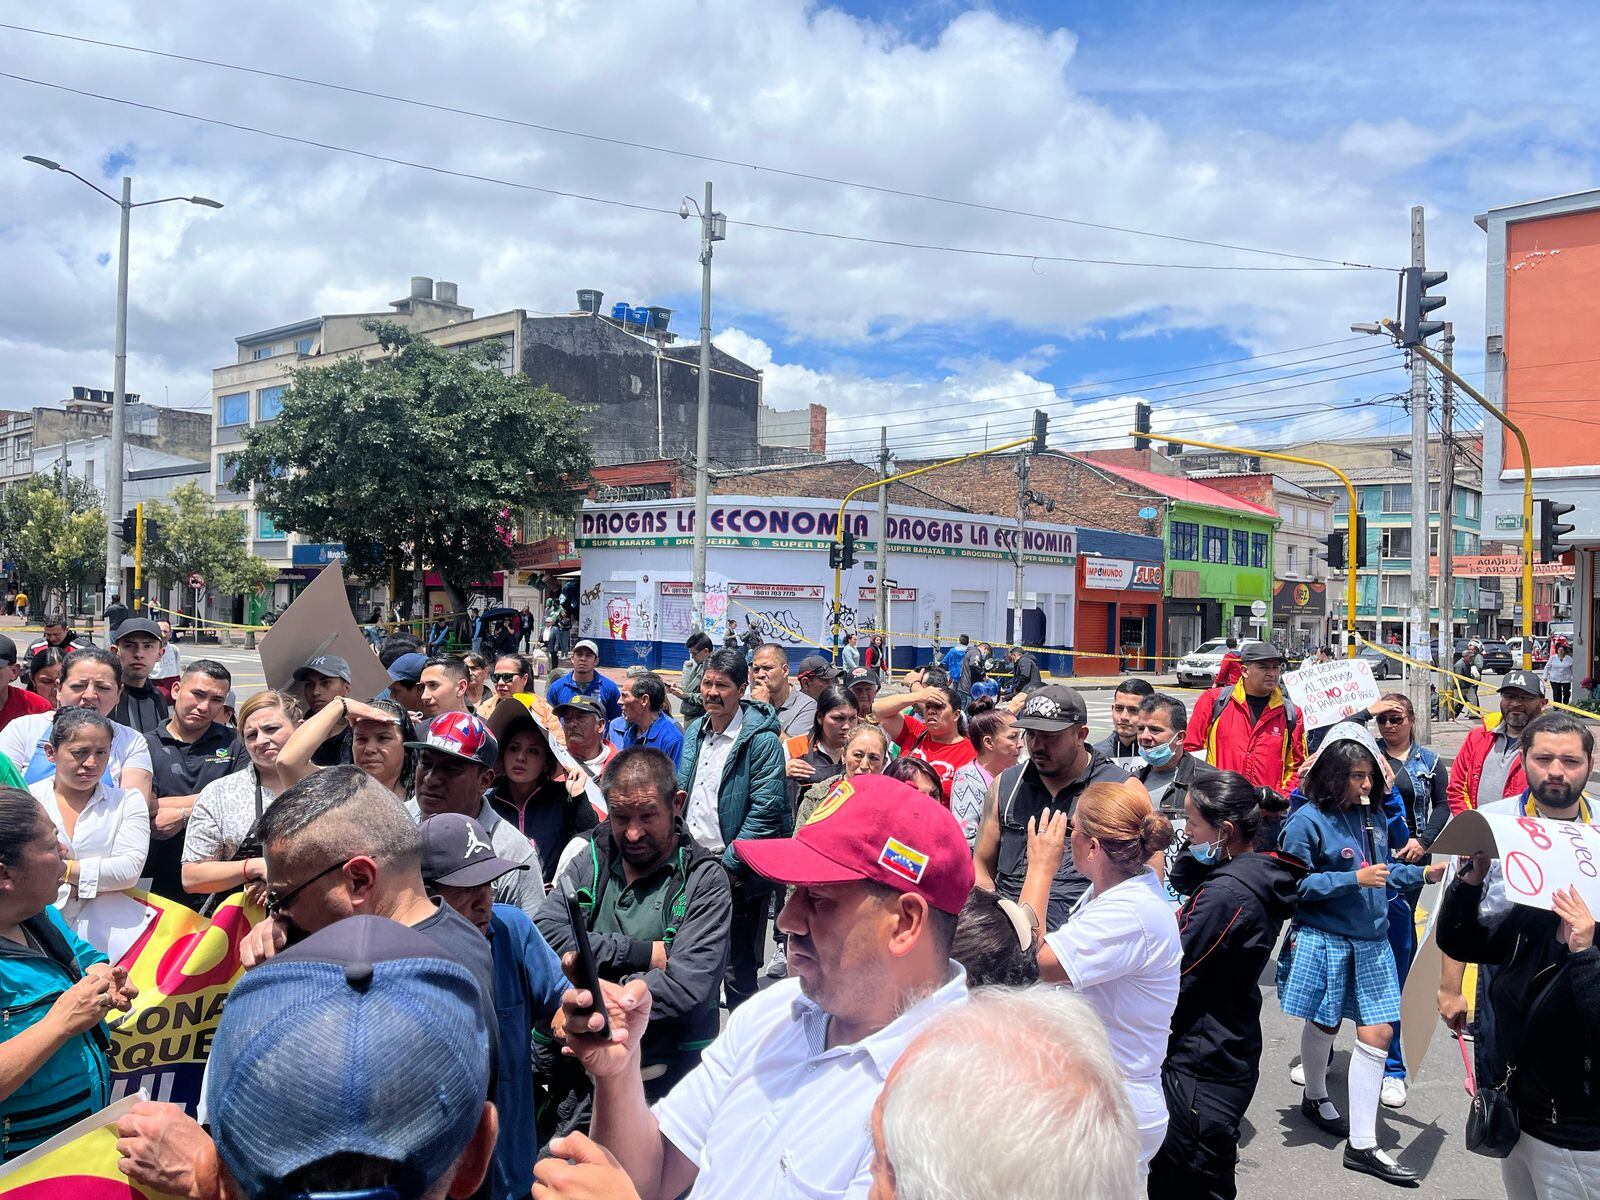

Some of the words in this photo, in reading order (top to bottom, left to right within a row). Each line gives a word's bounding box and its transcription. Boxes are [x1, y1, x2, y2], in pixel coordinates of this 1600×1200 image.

[582, 511, 667, 534] DROGAS
[710, 509, 868, 537] ECONOMIA
[886, 517, 964, 544] DROGAS
[970, 524, 988, 546] LA
[591, 539, 618, 547] SUPER
[619, 538, 657, 547] BARATAS
[771, 540, 814, 549] SUPER
[913, 547, 945, 555] BARATAS
[961, 550, 1003, 559] DROGUERIA
[1298, 669, 1318, 681] POR
[1317, 661, 1350, 675] DERECHO
[1508, 673, 1527, 686] LA
[1304, 682, 1321, 695] AL
[1317, 671, 1353, 688] TRABAJO
[1325, 686, 1342, 700] NO
[1303, 703, 1318, 716] AL
[106, 1027, 218, 1071] RQUE
